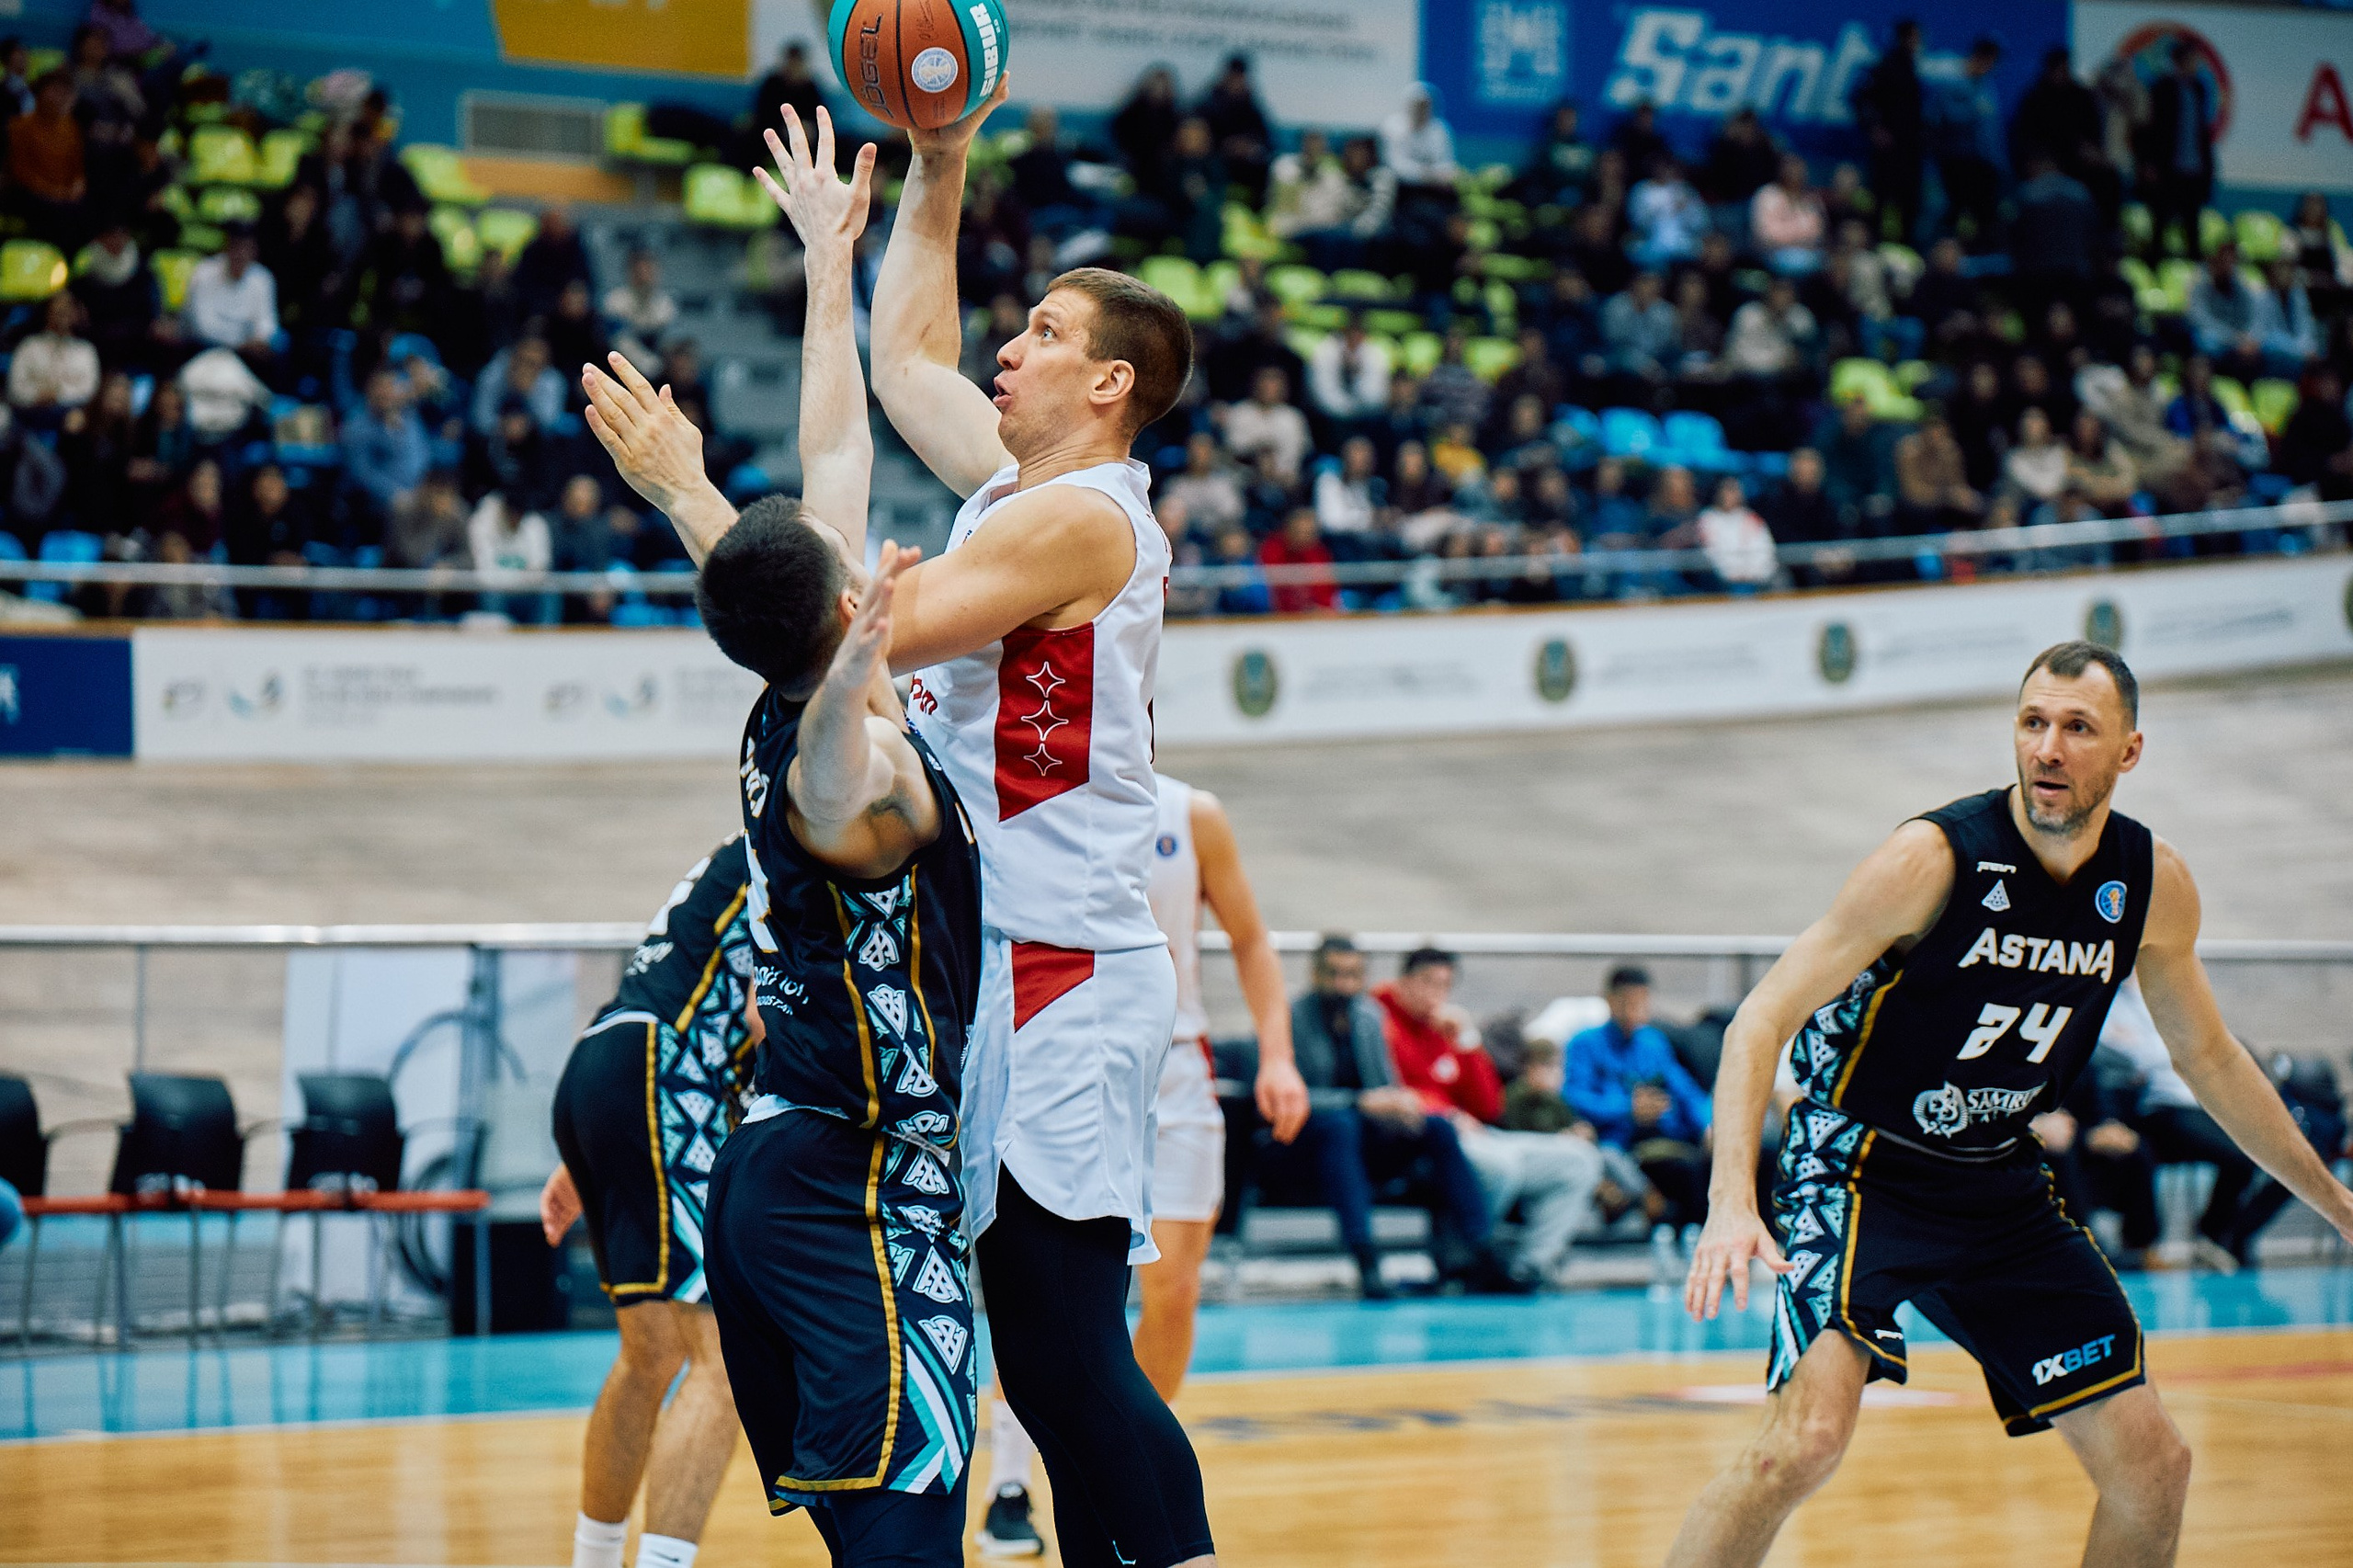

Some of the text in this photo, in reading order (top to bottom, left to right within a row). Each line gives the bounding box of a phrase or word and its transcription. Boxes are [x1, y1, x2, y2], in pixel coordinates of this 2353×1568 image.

[859, 13, 895, 119] JÖGEL
[970, 2, 999, 97] SIBUR
[1958, 927, 2114, 983] ASTANA
[1956, 1002, 2073, 1063] 24
